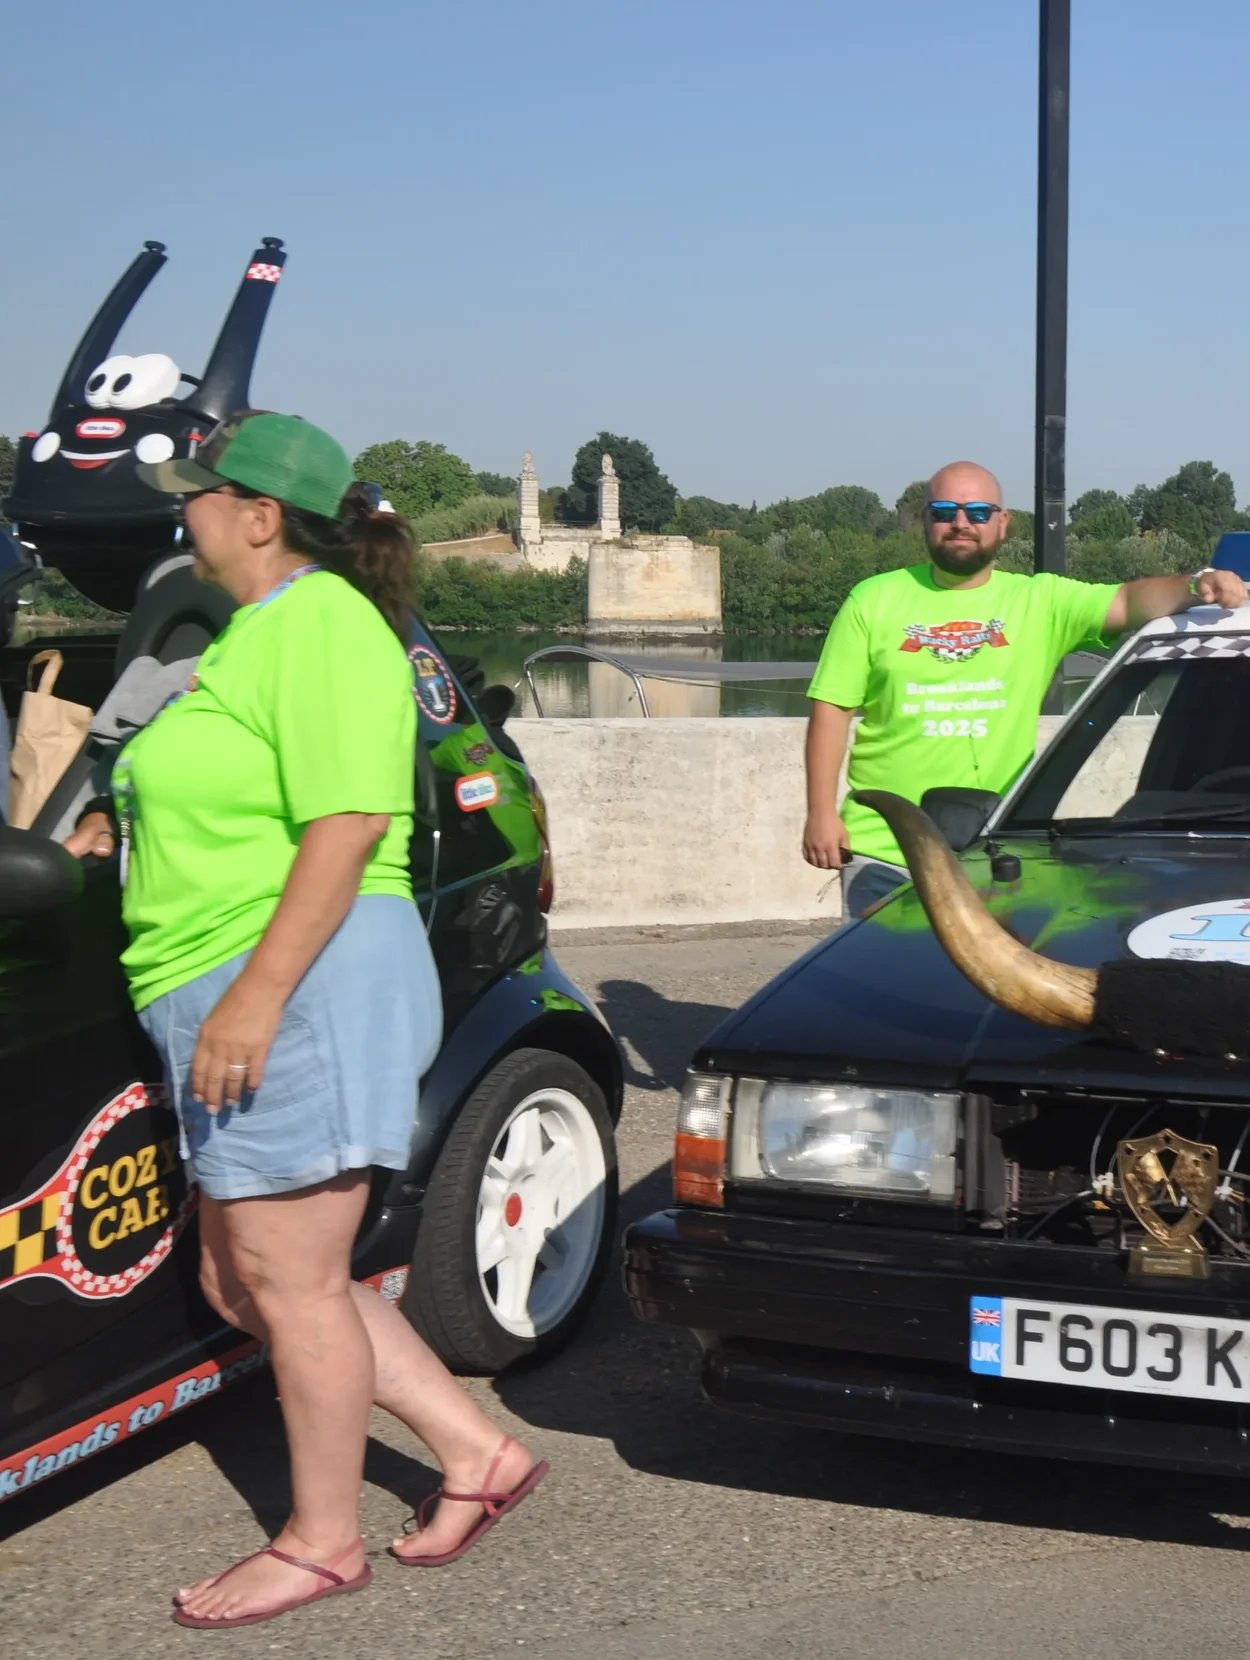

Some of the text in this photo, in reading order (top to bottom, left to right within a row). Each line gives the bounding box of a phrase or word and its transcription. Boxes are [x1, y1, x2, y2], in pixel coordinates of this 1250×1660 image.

[921, 718, 988, 738] 2025
[89, 1185, 169, 1250] CAR
[971, 1341, 1001, 1364] UK
[1015, 1308, 1183, 1383] F603
[128, 1400, 165, 1433] to
